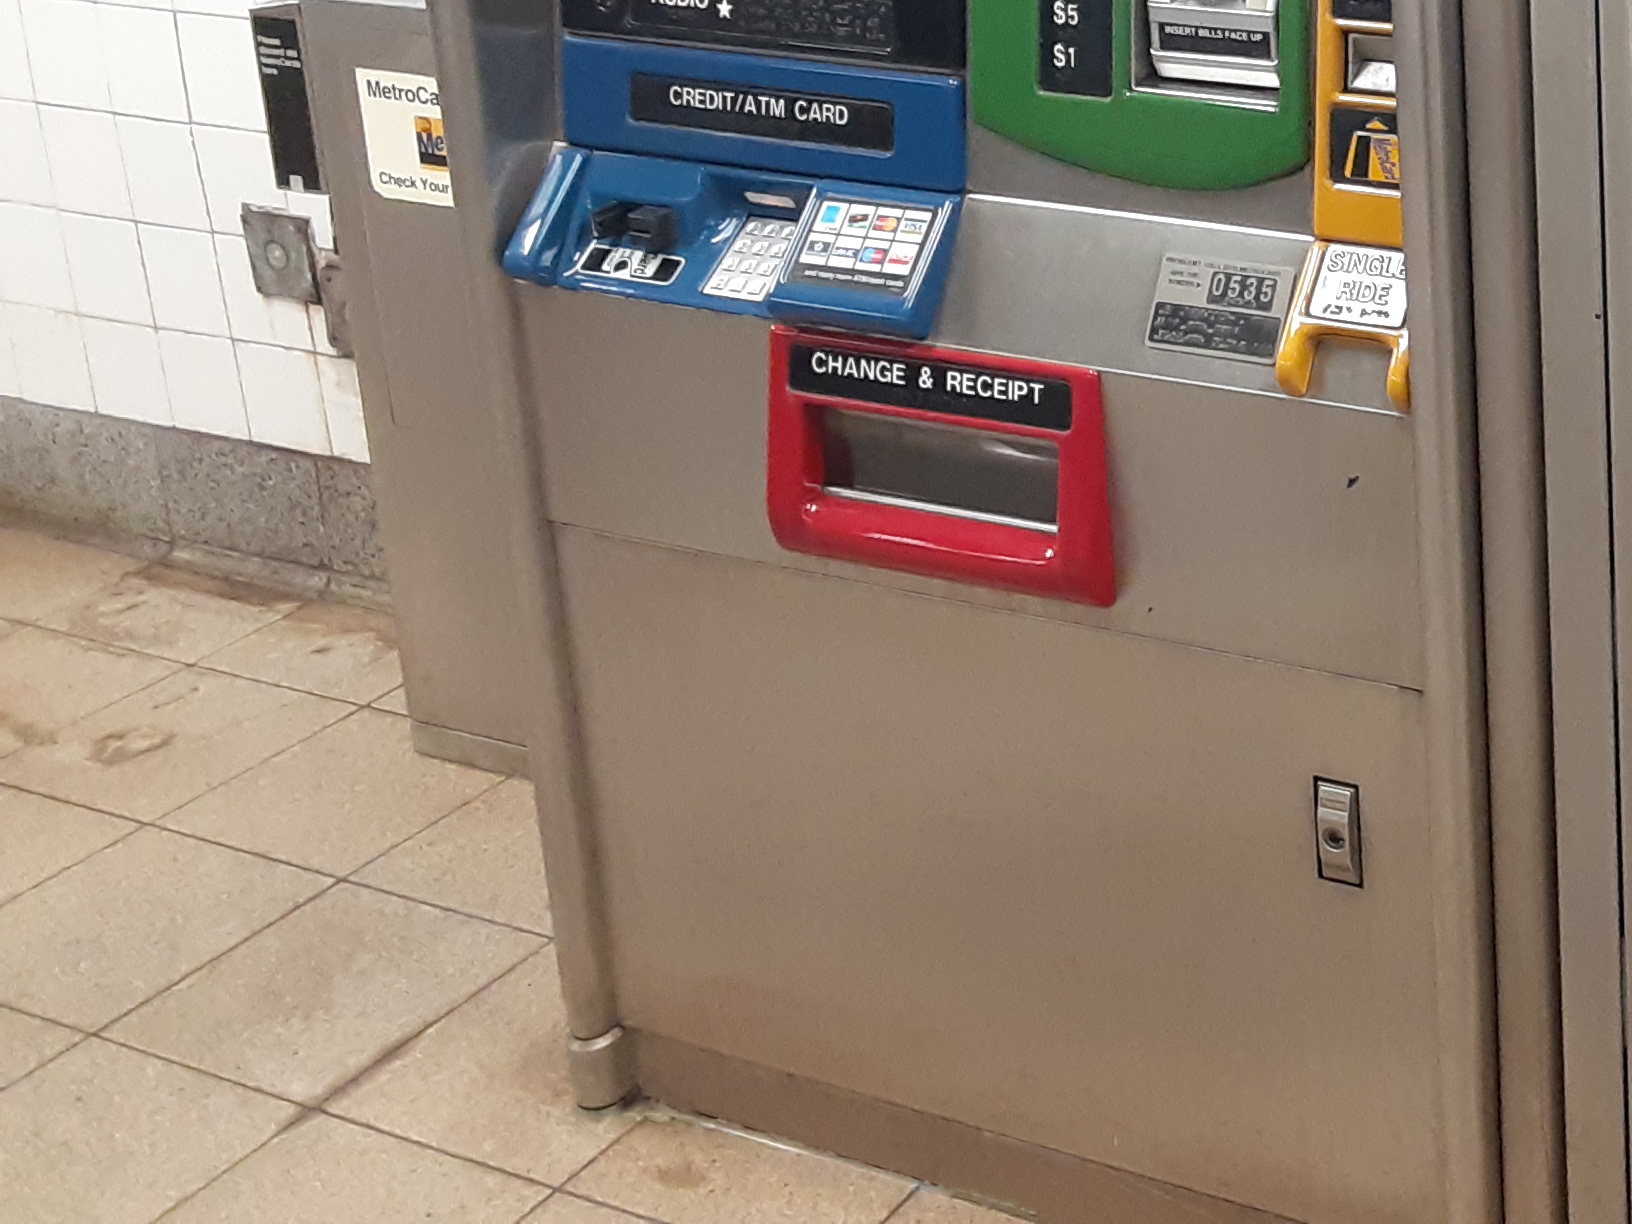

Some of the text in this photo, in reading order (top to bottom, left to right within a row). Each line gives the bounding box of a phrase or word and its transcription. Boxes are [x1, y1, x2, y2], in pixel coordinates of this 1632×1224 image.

[1053, 0, 1079, 26] $5
[1164, 24, 1264, 42] INSERT BILLS FACE UP
[1053, 43, 1077, 69] $1
[366, 78, 440, 107] MetroCa
[669, 84, 849, 125] CREDIT/ATM CARD
[379, 171, 450, 194] Check Your
[1211, 273, 1275, 302] 0535
[1336, 279, 1393, 306] RIDE
[811, 351, 1044, 405] CHANGE & RECEIPT
